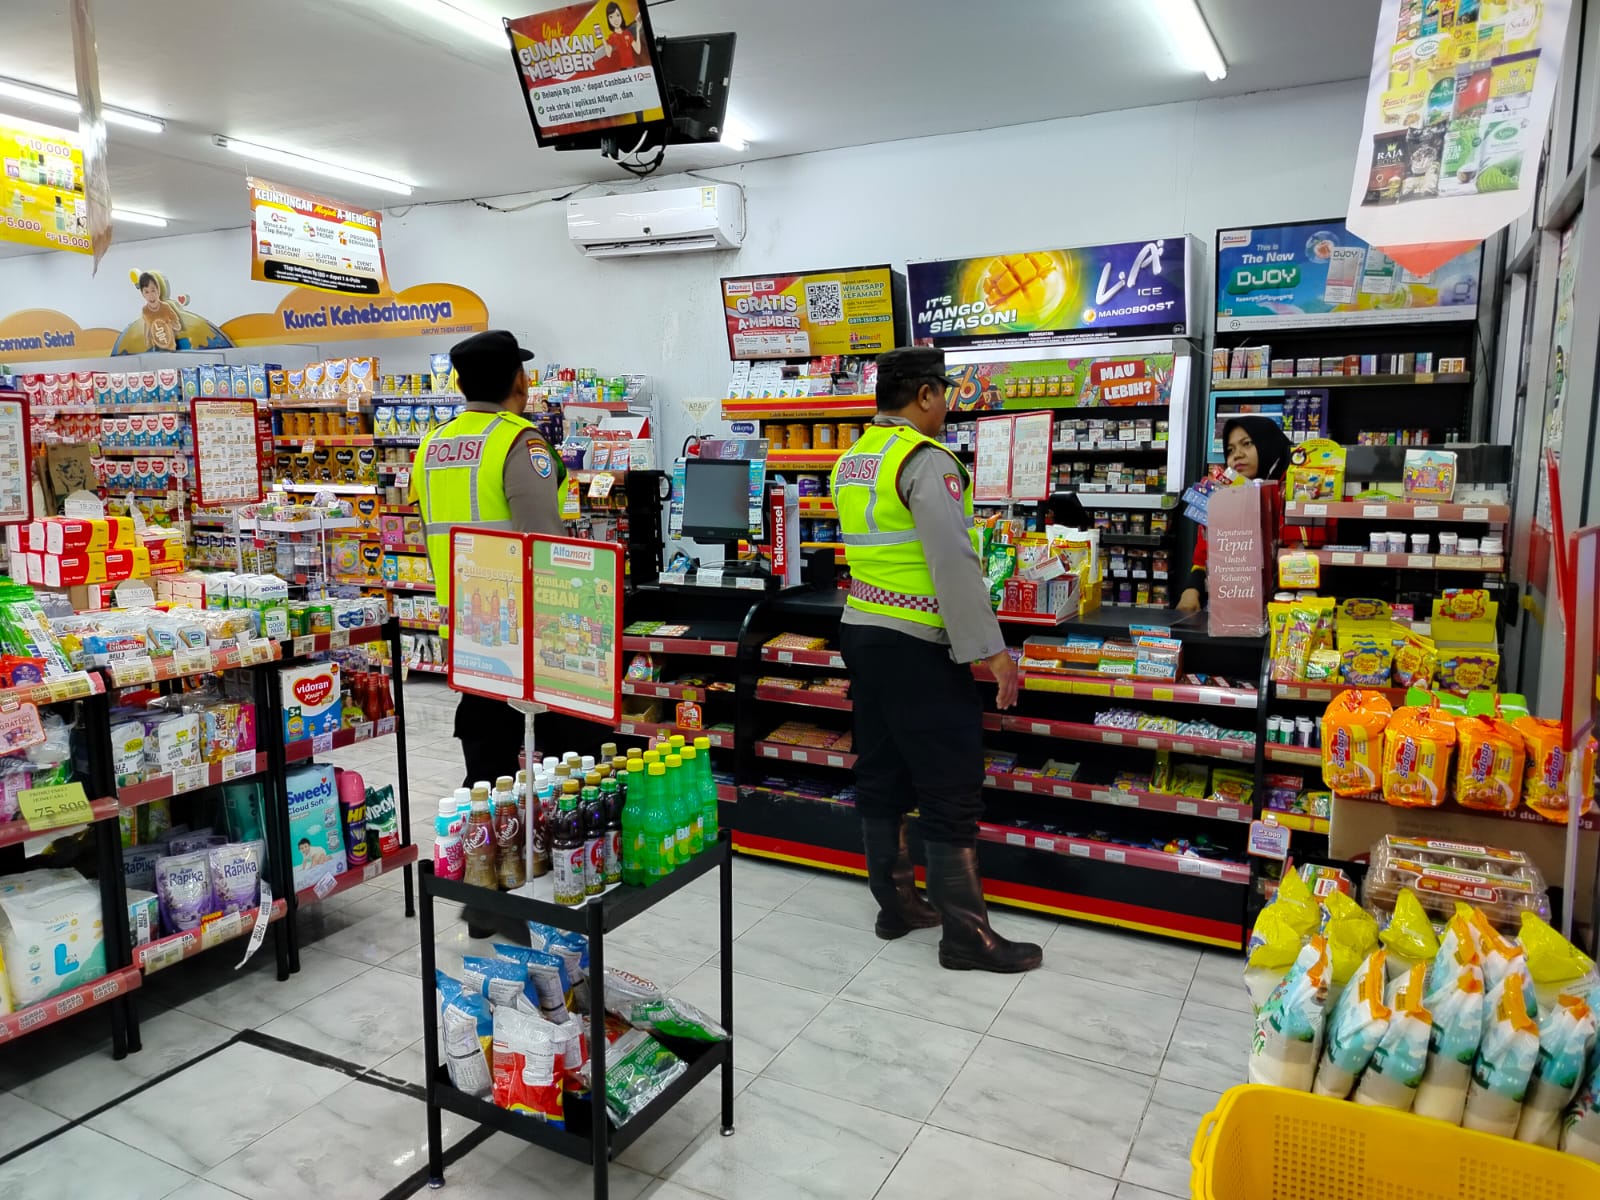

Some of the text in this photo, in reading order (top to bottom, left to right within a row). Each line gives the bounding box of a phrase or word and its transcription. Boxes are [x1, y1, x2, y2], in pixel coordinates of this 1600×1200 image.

[519, 34, 595, 66] GUNAKAN
[527, 55, 595, 82] MEMBER
[541, 88, 562, 100] Belanja
[604, 76, 632, 88] Cashback
[30, 139, 70, 157] 10.000
[255, 188, 314, 212] KEUNTUNGAN
[58, 234, 90, 249] 15.000
[1257, 243, 1273, 252] This
[1237, 268, 1297, 286] DJOY
[842, 282, 885, 292] WHATSAPP
[1137, 286, 1163, 297] ICE
[736, 294, 798, 314] GRATIS
[926, 296, 952, 309] IT'S
[1098, 300, 1175, 319] MANGOBOOST
[283, 301, 453, 329] Kunci Kehebatannya
[918, 300, 985, 324] MANGO
[929, 309, 1017, 334] SEASON!
[43, 330, 76, 348] Sehat
[1101, 362, 1136, 381] MAU
[1103, 380, 1152, 401] LEBIH?
[836, 458, 881, 481] POLISI
[774, 505, 784, 569] Telkomsel
[1216, 528, 1253, 538] Keputusan
[553, 546, 592, 561] Alfamart
[1217, 538, 1255, 556] Tepat
[1224, 555, 1247, 564] Untuk
[1221, 574, 1251, 584] Keluarga
[261, 585, 288, 593] INDOMILK
[535, 587, 580, 609] CEBAN
[1217, 585, 1255, 599] Sehat
[1139, 663, 1170, 675] Strepsils
[296, 679, 330, 694] vidoran
[304, 690, 325, 702] Xmart
[289, 707, 300, 717] 3+
[286, 780, 333, 806] Sweety
[288, 798, 325, 816] Cloud Soft
